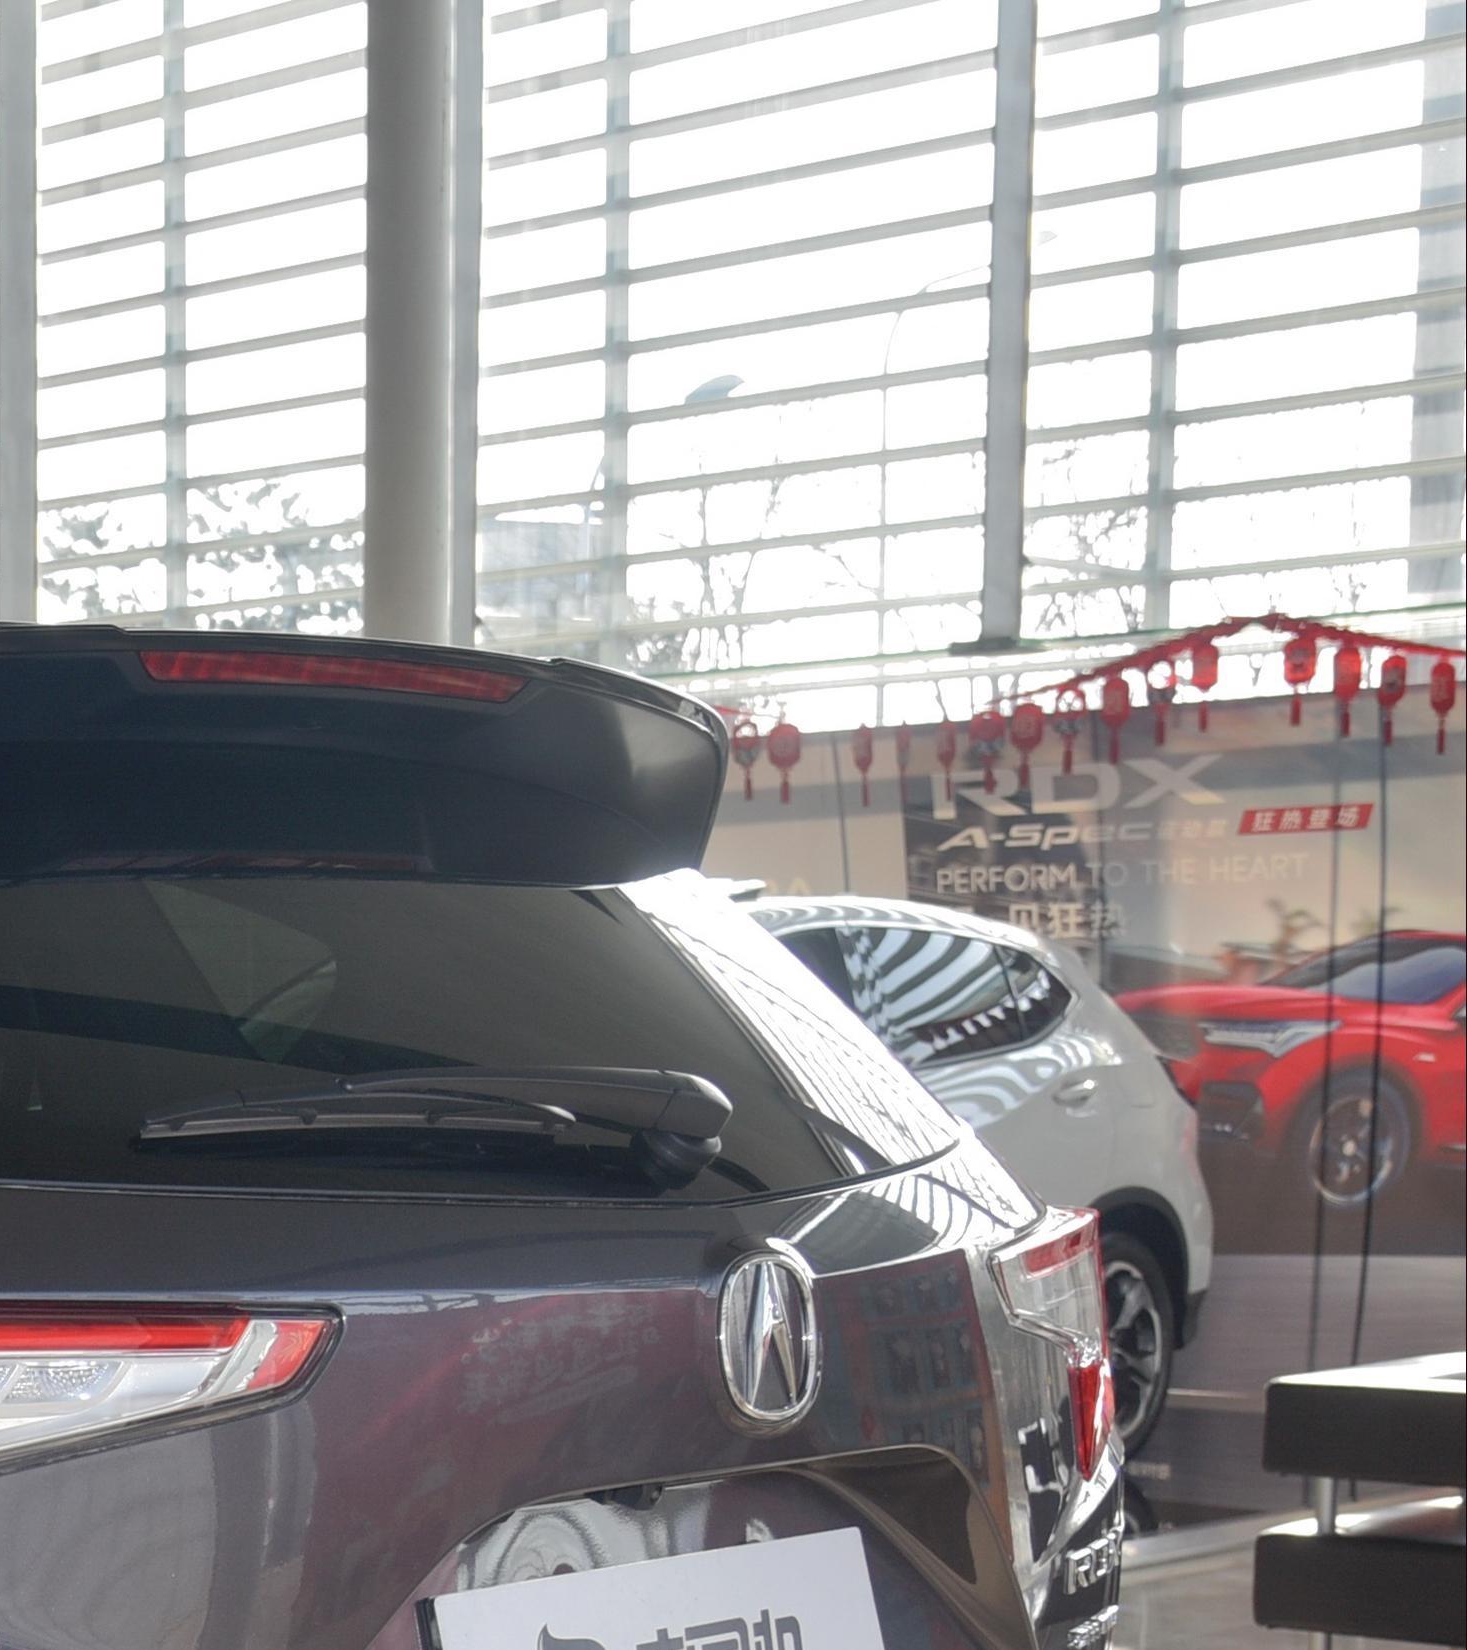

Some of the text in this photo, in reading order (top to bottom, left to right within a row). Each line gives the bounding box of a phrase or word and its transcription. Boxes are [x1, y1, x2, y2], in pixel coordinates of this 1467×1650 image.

[931, 754, 1227, 820] RDX
[936, 821, 1154, 852] A-Spec
[1250, 805, 1361, 834] 狂热登场
[935, 852, 1310, 896] PERFORM TO THE HEART
